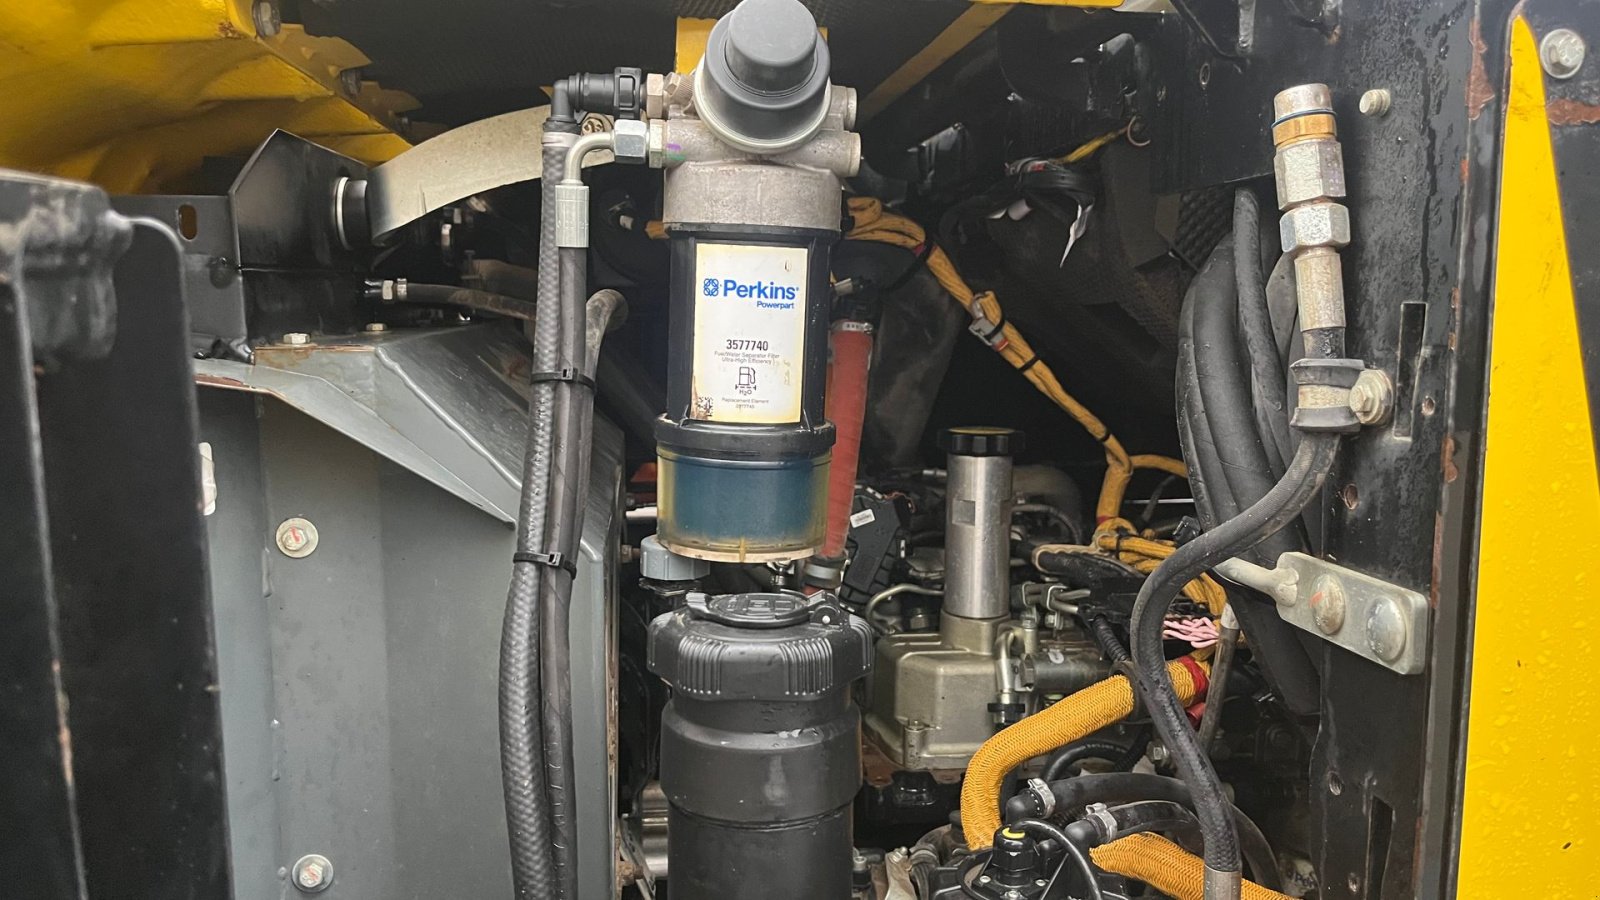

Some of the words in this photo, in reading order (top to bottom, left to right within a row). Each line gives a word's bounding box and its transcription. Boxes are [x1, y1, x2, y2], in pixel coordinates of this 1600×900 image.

[723, 279, 796, 300] Perkins
[756, 300, 795, 310] Powerpart
[726, 339, 769, 351] 3577740
[741, 352, 767, 360] Separator
